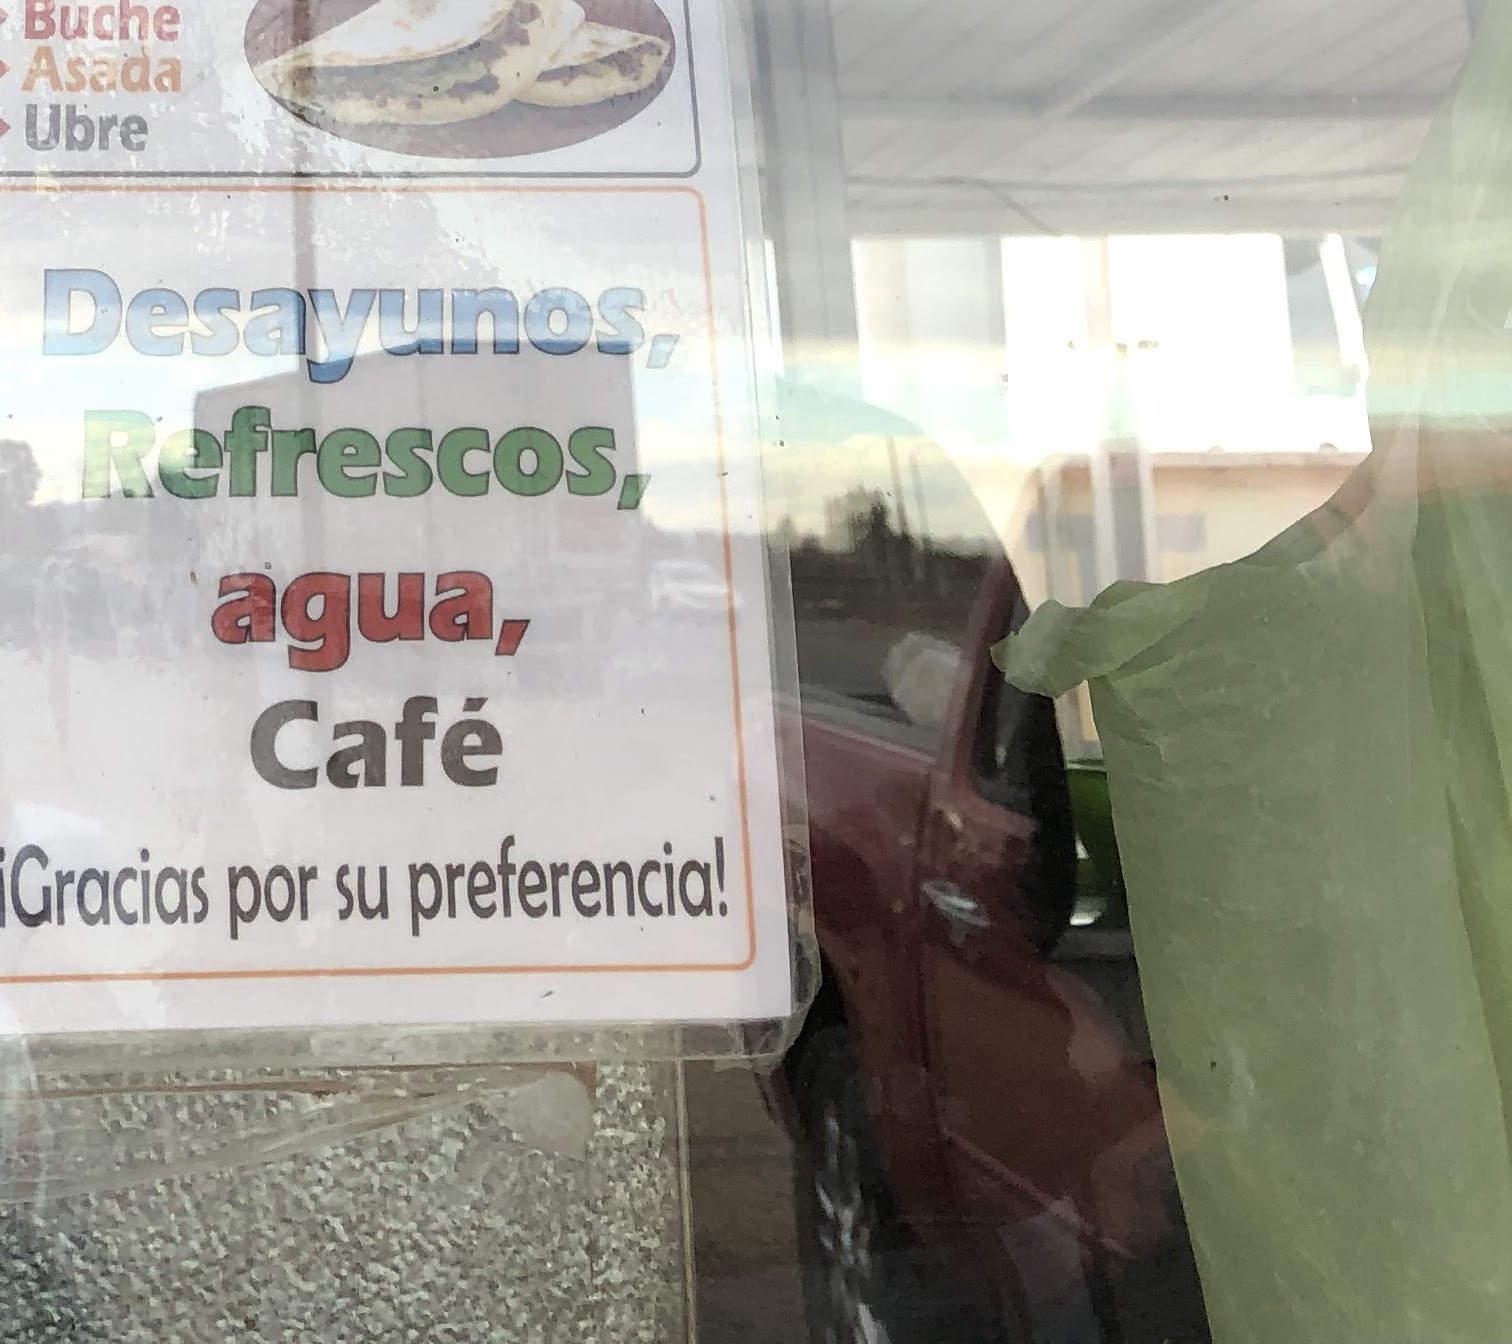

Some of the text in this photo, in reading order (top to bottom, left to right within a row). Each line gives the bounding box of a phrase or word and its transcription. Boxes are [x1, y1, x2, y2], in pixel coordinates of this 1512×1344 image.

[22, 47, 183, 94] Asada
[24, 104, 149, 153] Ubre
[41, 267, 679, 384] Desayunos,
[83, 405, 652, 511] Refrescos,
[210, 570, 531, 673] agua,
[250, 696, 504, 789] Café
[229, 864, 318, 939] por
[339, 865, 388, 920] su
[408, 836, 728, 937] preferencia!
